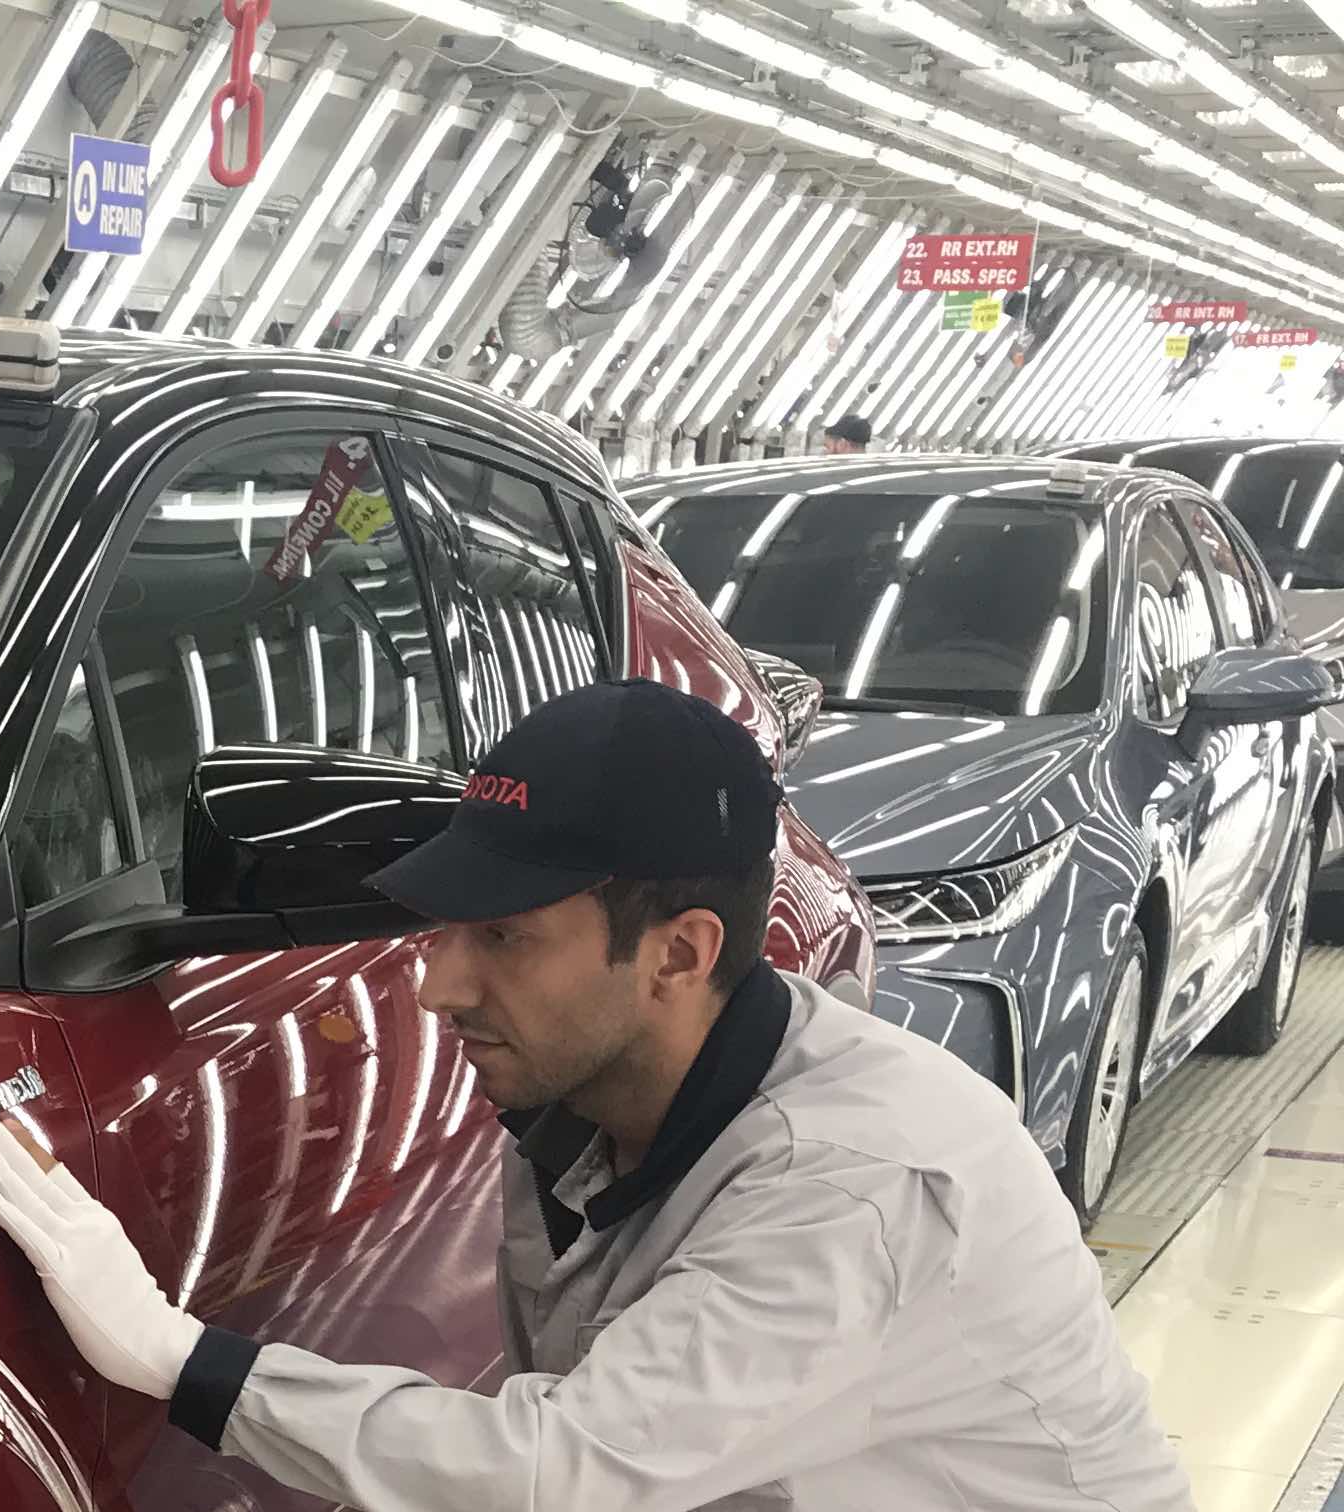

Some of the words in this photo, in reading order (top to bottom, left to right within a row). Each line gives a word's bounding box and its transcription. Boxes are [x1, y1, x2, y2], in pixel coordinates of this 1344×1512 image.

[102, 160, 117, 193] IN
[118, 162, 146, 196] LINE
[100, 202, 144, 238] REPAIR
[906, 242, 928, 259] 22.
[941, 241, 962, 257] RR
[902, 268, 924, 286] 23.
[933, 268, 975, 285] PASS.
[977, 268, 1018, 285] SPEC
